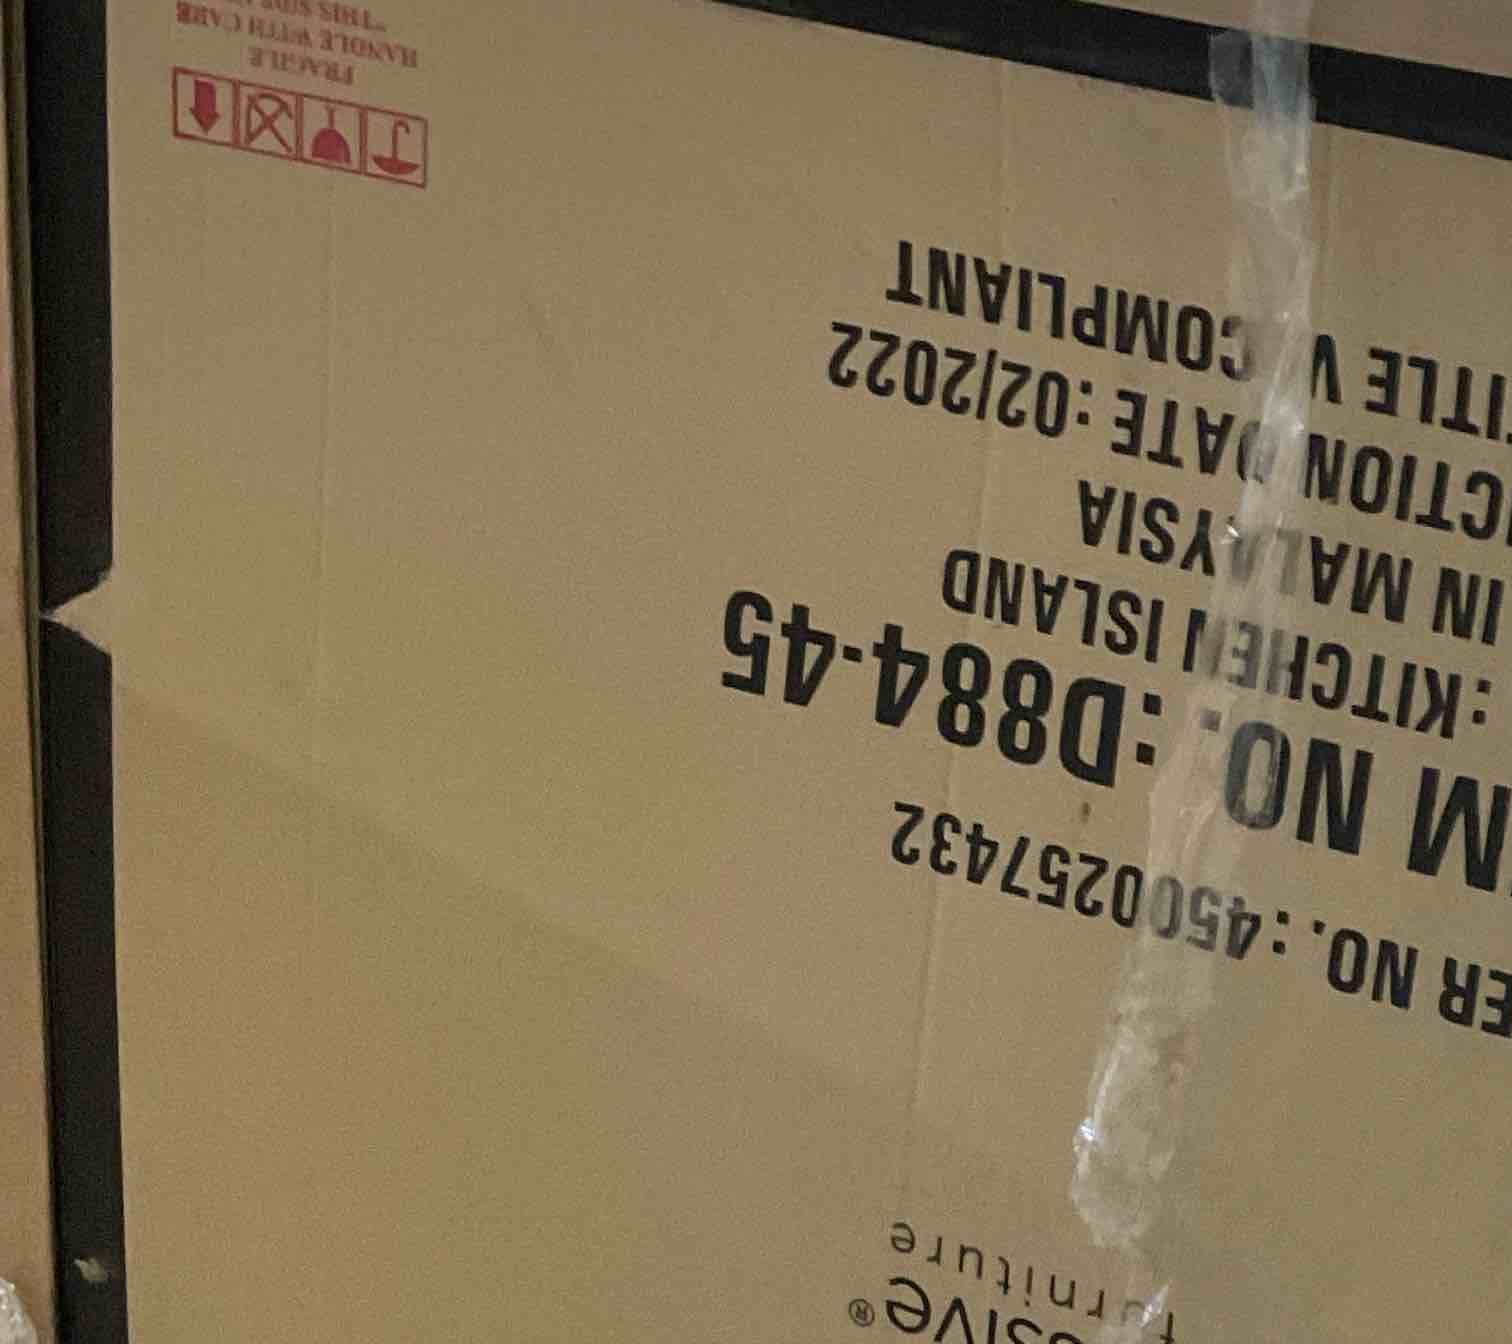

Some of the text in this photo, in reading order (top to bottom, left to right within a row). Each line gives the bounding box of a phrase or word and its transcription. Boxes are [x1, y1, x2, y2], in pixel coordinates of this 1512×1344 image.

[176, 0, 417, 69] HANDLE WITH CARE
[247, 47, 353, 86] FRAGILE
[885, 241, 1256, 383] COMPLIANT
[1113, 386, 1277, 485] DATE
[1076, 481, 1412, 619] MALAYSIA
[940, 548, 1162, 666] ISLAND
[1438, 567, 1502, 645] IN
[719, 590, 1163, 788] :D884-45
[1202, 711, 1373, 857] NO.
[1310, 919, 1418, 1011] NO.
